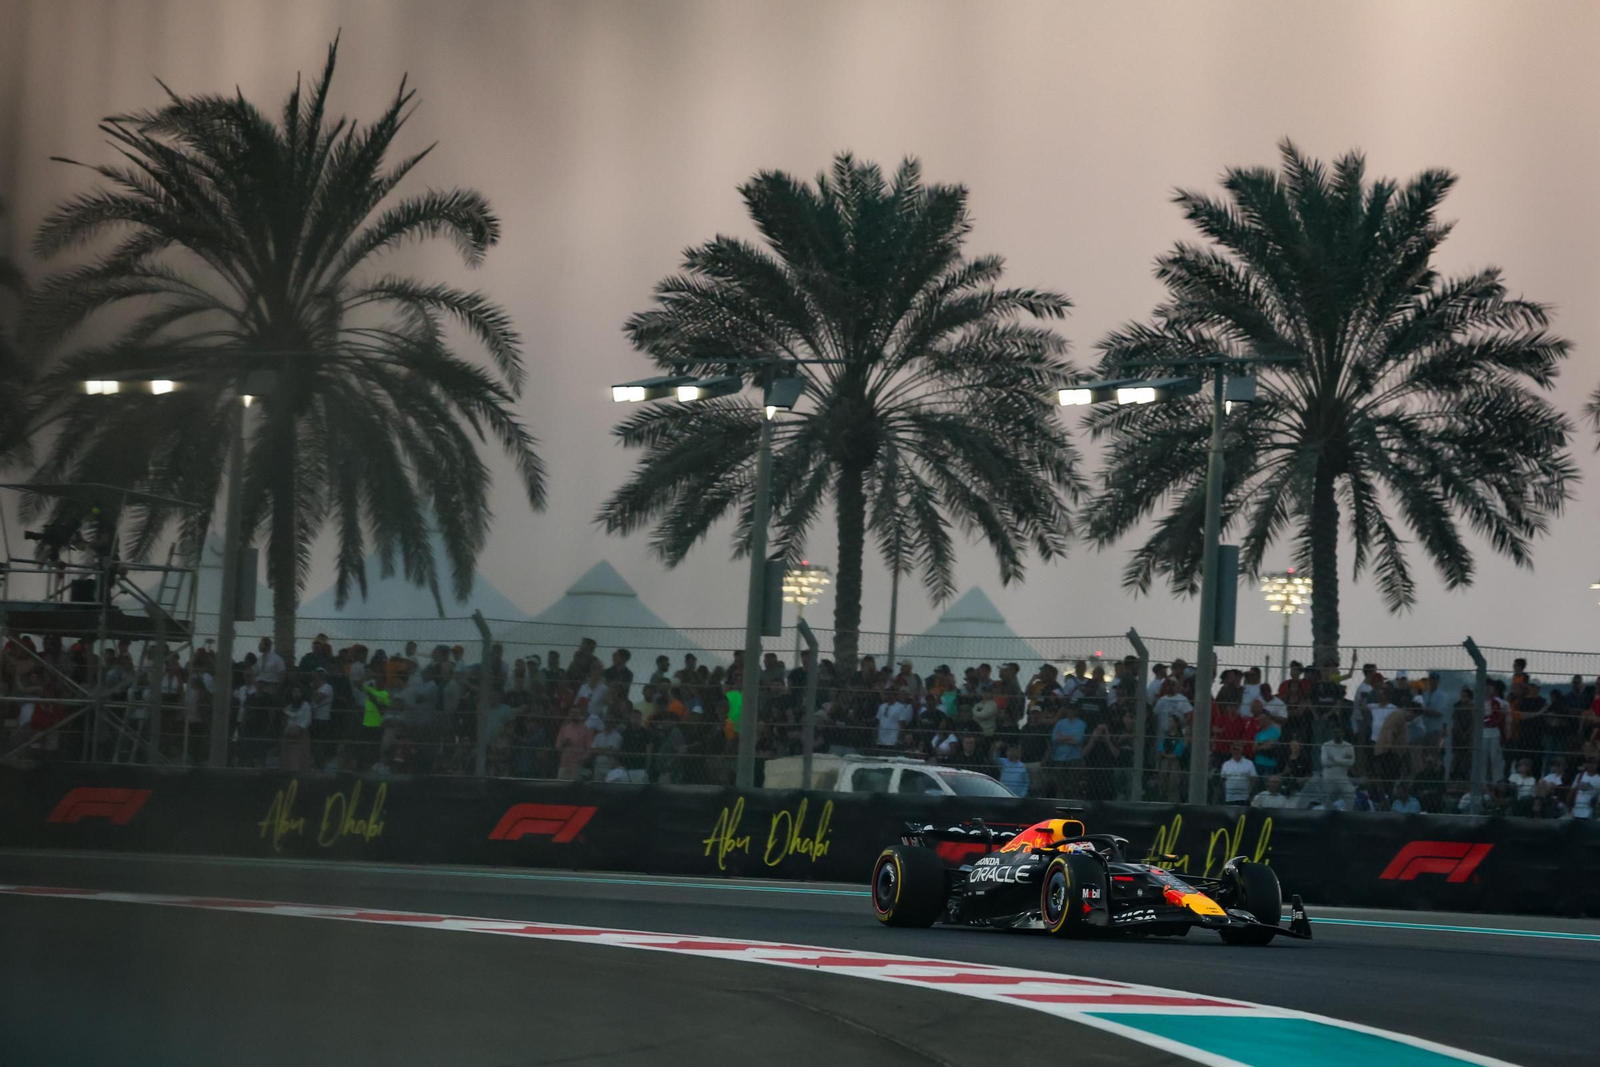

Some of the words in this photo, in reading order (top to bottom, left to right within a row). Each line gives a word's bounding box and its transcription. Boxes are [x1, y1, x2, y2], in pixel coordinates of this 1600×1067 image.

[47, 787, 153, 825] F1
[257, 778, 305, 852] Abu
[317, 779, 388, 847] Dhabi
[488, 803, 598, 844] F1
[703, 796, 750, 870] Abu
[763, 796, 834, 867] Dhabi
[1202, 814, 1273, 882] Dhbi
[969, 864, 1033, 884] ORACLE
[1378, 840, 1495, 883] F1
[1082, 888, 1101, 899] Mobil
[1113, 909, 1157, 922] VISA
